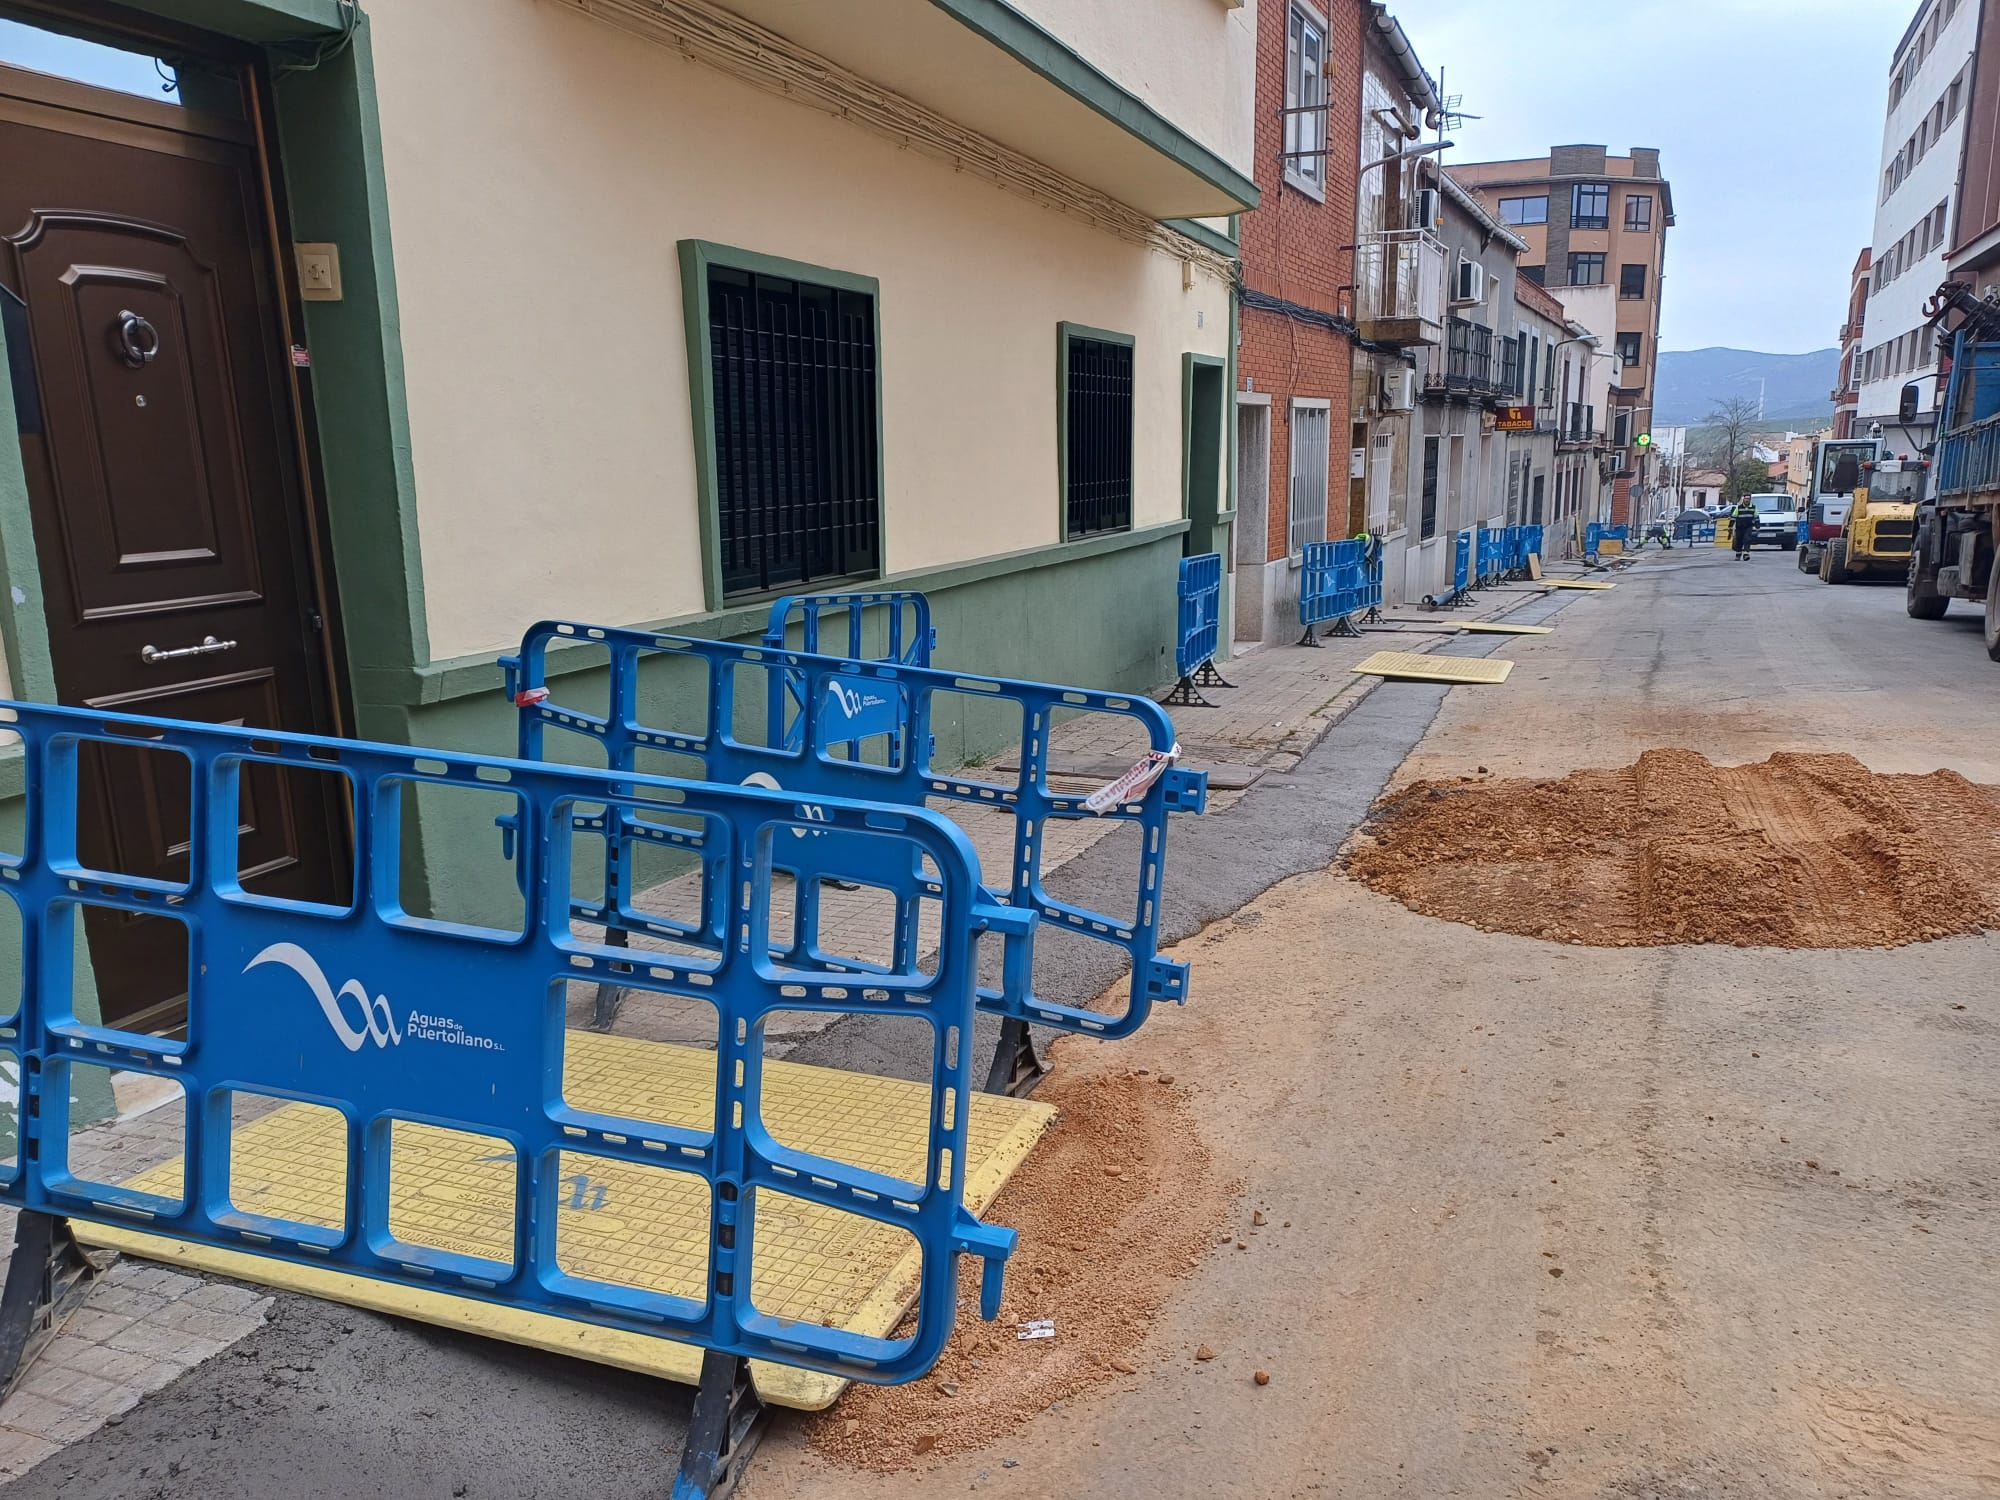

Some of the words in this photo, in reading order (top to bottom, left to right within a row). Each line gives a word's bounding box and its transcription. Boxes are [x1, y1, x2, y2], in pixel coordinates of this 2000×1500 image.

[1498, 420, 1532, 428] TABACOS
[409, 1010, 454, 1028] Aguas
[453, 1023, 463, 1031] de
[407, 1023, 493, 1049] Puertollano
